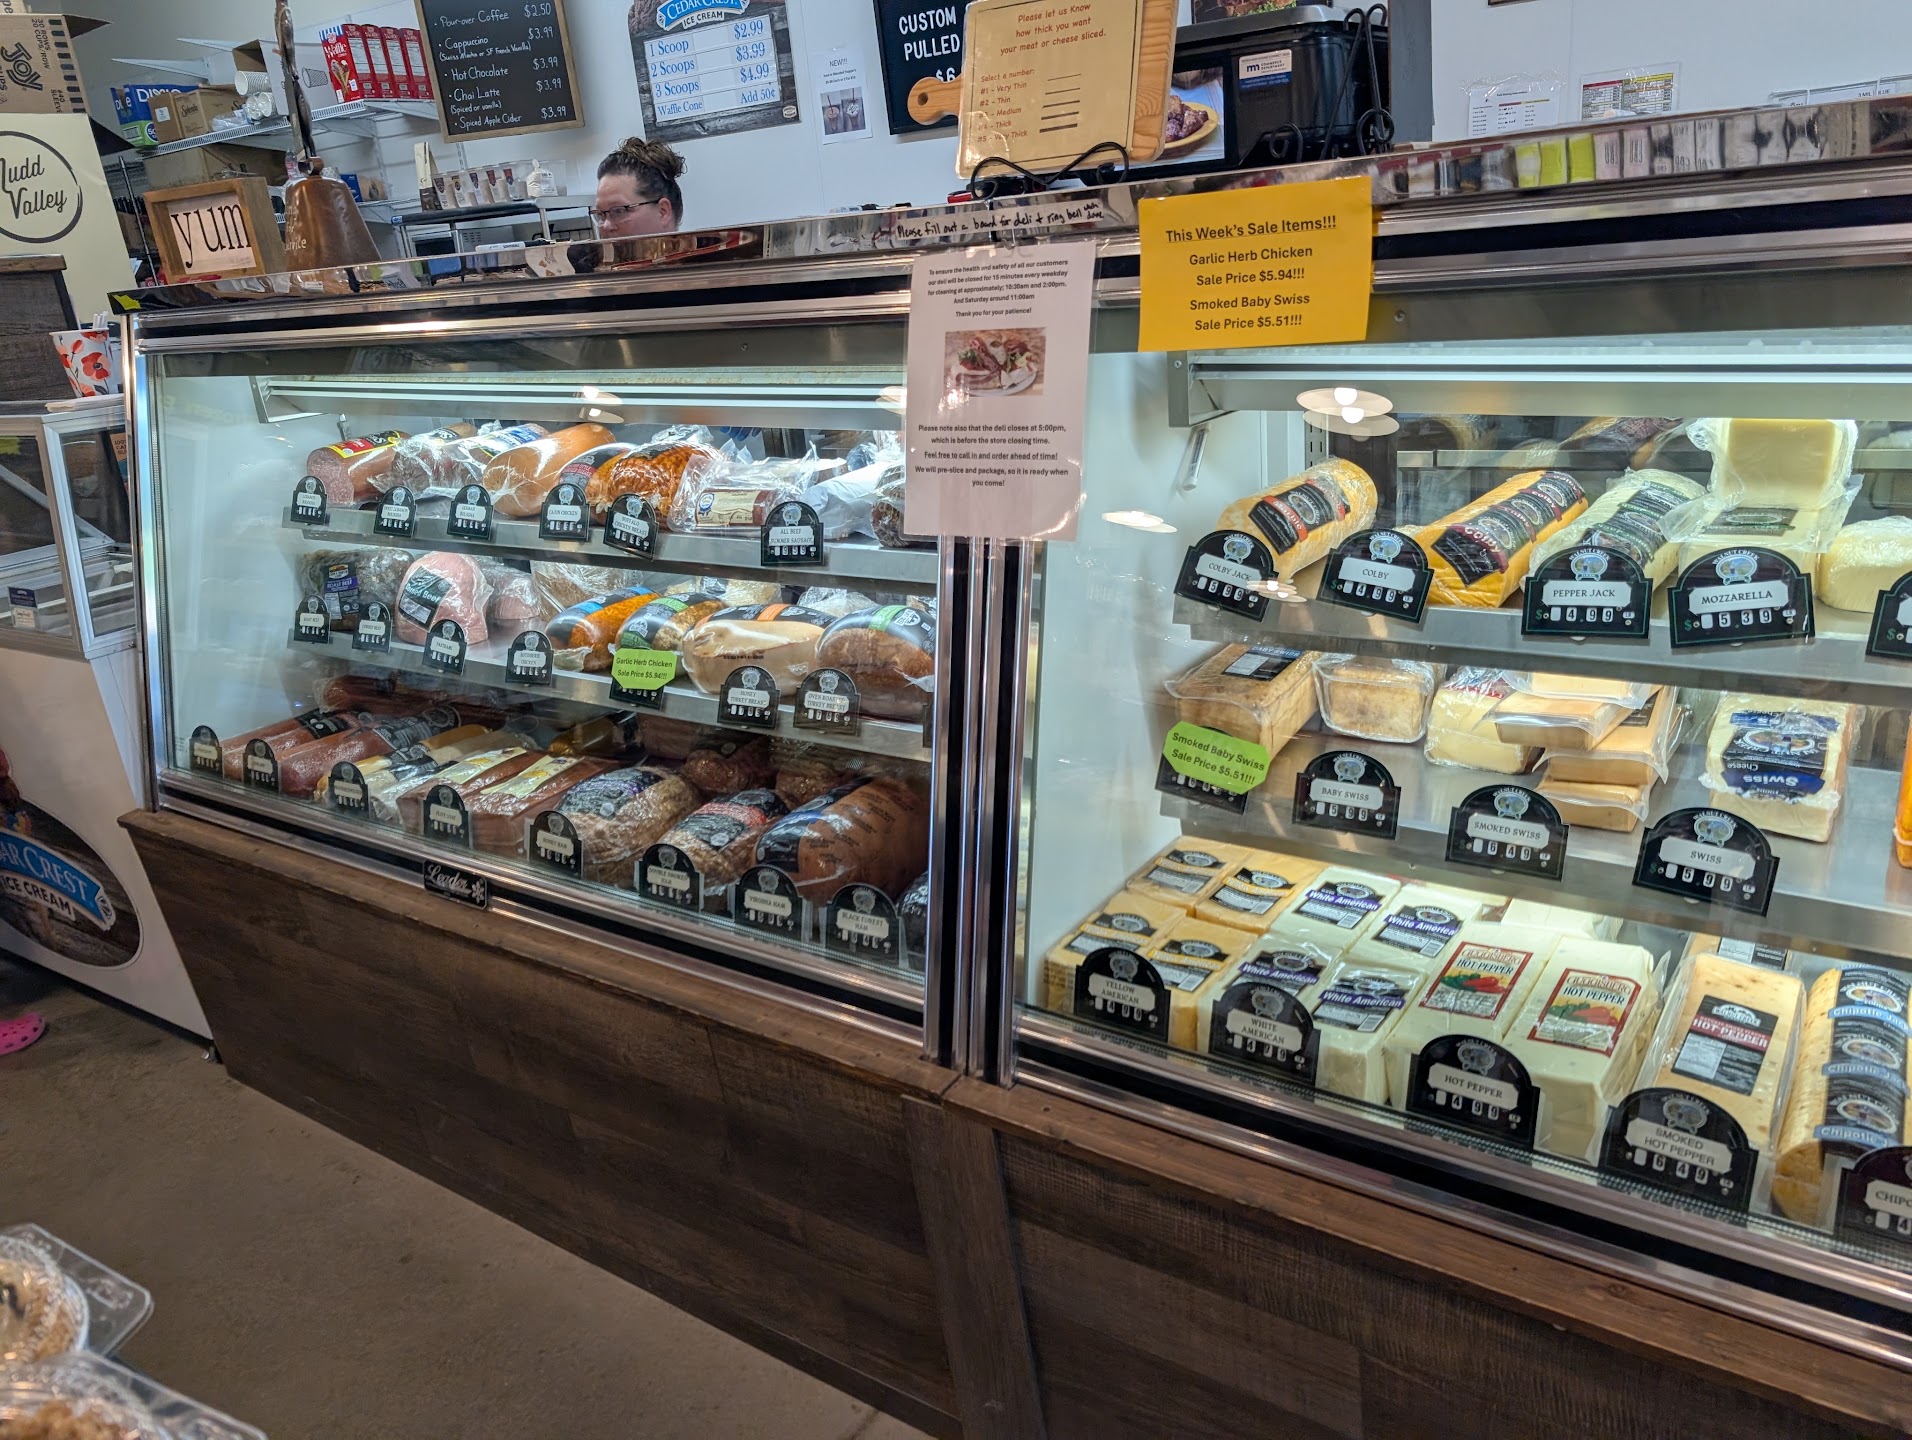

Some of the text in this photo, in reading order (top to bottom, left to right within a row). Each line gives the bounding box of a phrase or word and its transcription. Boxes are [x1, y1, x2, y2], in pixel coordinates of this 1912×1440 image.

[440, 3, 551, 27] Pour-over Coffee $2.50
[684, 11, 722, 26] ICE CREAM
[899, 6, 956, 34] CUSTOM
[1018, 12, 1042, 23] Please
[1046, 10, 1056, 18] let
[1070, 4, 1092, 14] Know
[658, 20, 764, 55] Scoop $2.99
[1016, 17, 1092, 38] how thick you want
[40, 30, 51, 50] ROWS
[445, 26, 553, 53] Cappuccino $3.99
[904, 34, 960, 60] PULLED
[1000, 28, 1106, 56] your meat or cheese sliced.
[0, 42, 43, 91] JOY
[451, 56, 558, 81] Hot Chocolate $3.99
[650, 42, 766, 78] 2 Scoops $3.99
[664, 62, 770, 96] Scoops $4.99
[981, 68, 1034, 82] Select number:
[454, 78, 562, 102] Chai Latte $3.99
[997, 84, 1012, 93] Very
[658, 91, 758, 116] Waffle Cone Add
[996, 107, 1022, 117] Medium
[459, 106, 566, 131] Spiced Apple Cider $3.99
[996, 120, 1012, 128] Thick
[1011, 130, 1028, 138] Thick
[10, 186, 68, 220] Valley
[897, 208, 1082, 238] Please fill out board deli ring bell
[1166, 216, 1336, 242] This Week's Sale Items!!!
[170, 203, 252, 268] yum
[1190, 246, 1312, 266] Garlic Herb Chicken
[1042, 270, 1068, 278] weekday
[1196, 268, 1304, 286] Sale Price $5.94!!!
[964, 296, 988, 304] Saturday
[1190, 293, 1310, 310] Smoked Baby Swiss
[1195, 314, 1302, 330] Sale Price $5.51!!!
[938, 466, 964, 474] pre-slice
[1208, 562, 1252, 581] COLBY JACK
[1362, 568, 1390, 580] COLBY
[1553, 589, 1615, 598] PEPPER JACK
[1702, 590, 1772, 604] MOZZARELLA
[648, 660, 672, 668] Chicken
[1172, 732, 1265, 771] Smoked Baby Swiss
[1172, 748, 1256, 785] Sale Price $5.51!!!
[1728, 762, 1758, 771] Cheese
[1743, 775, 1798, 787] Swiss
[1322, 788, 1370, 801] BABY SWISS
[1474, 820, 1542, 840] SMOKED SWISS
[1690, 850, 1722, 864] SWISS
[23, 846, 88, 900] CREST
[426, 864, 468, 890] Leader
[24, 880, 72, 916] CREAM
[1310, 891, 1378, 910] White American
[1388, 916, 1414, 928] White
[1242, 964, 1317, 984] White American
[1456, 958, 1514, 976] HOT PEPPER
[1101, 988, 1140, 1005] AMERICAN
[1105, 980, 1136, 994] YELLOW
[1563, 986, 1626, 1006] HOT PEPPER
[1322, 992, 1402, 1008] White American
[1834, 1007, 1882, 1018] Chipotle
[1242, 1024, 1285, 1045] AMERICAN
[1251, 1018, 1278, 1032] WHITE
[1692, 1018, 1720, 1032] HOT
[1720, 1027, 1768, 1048] PEPPER
[1445, 1074, 1503, 1100] HOT PEPPER
[1655, 1127, 1704, 1150] SMOKED
[1820, 1126, 1879, 1144] Chipotle
[1644, 1136, 1716, 1166] HOT PEPPER
